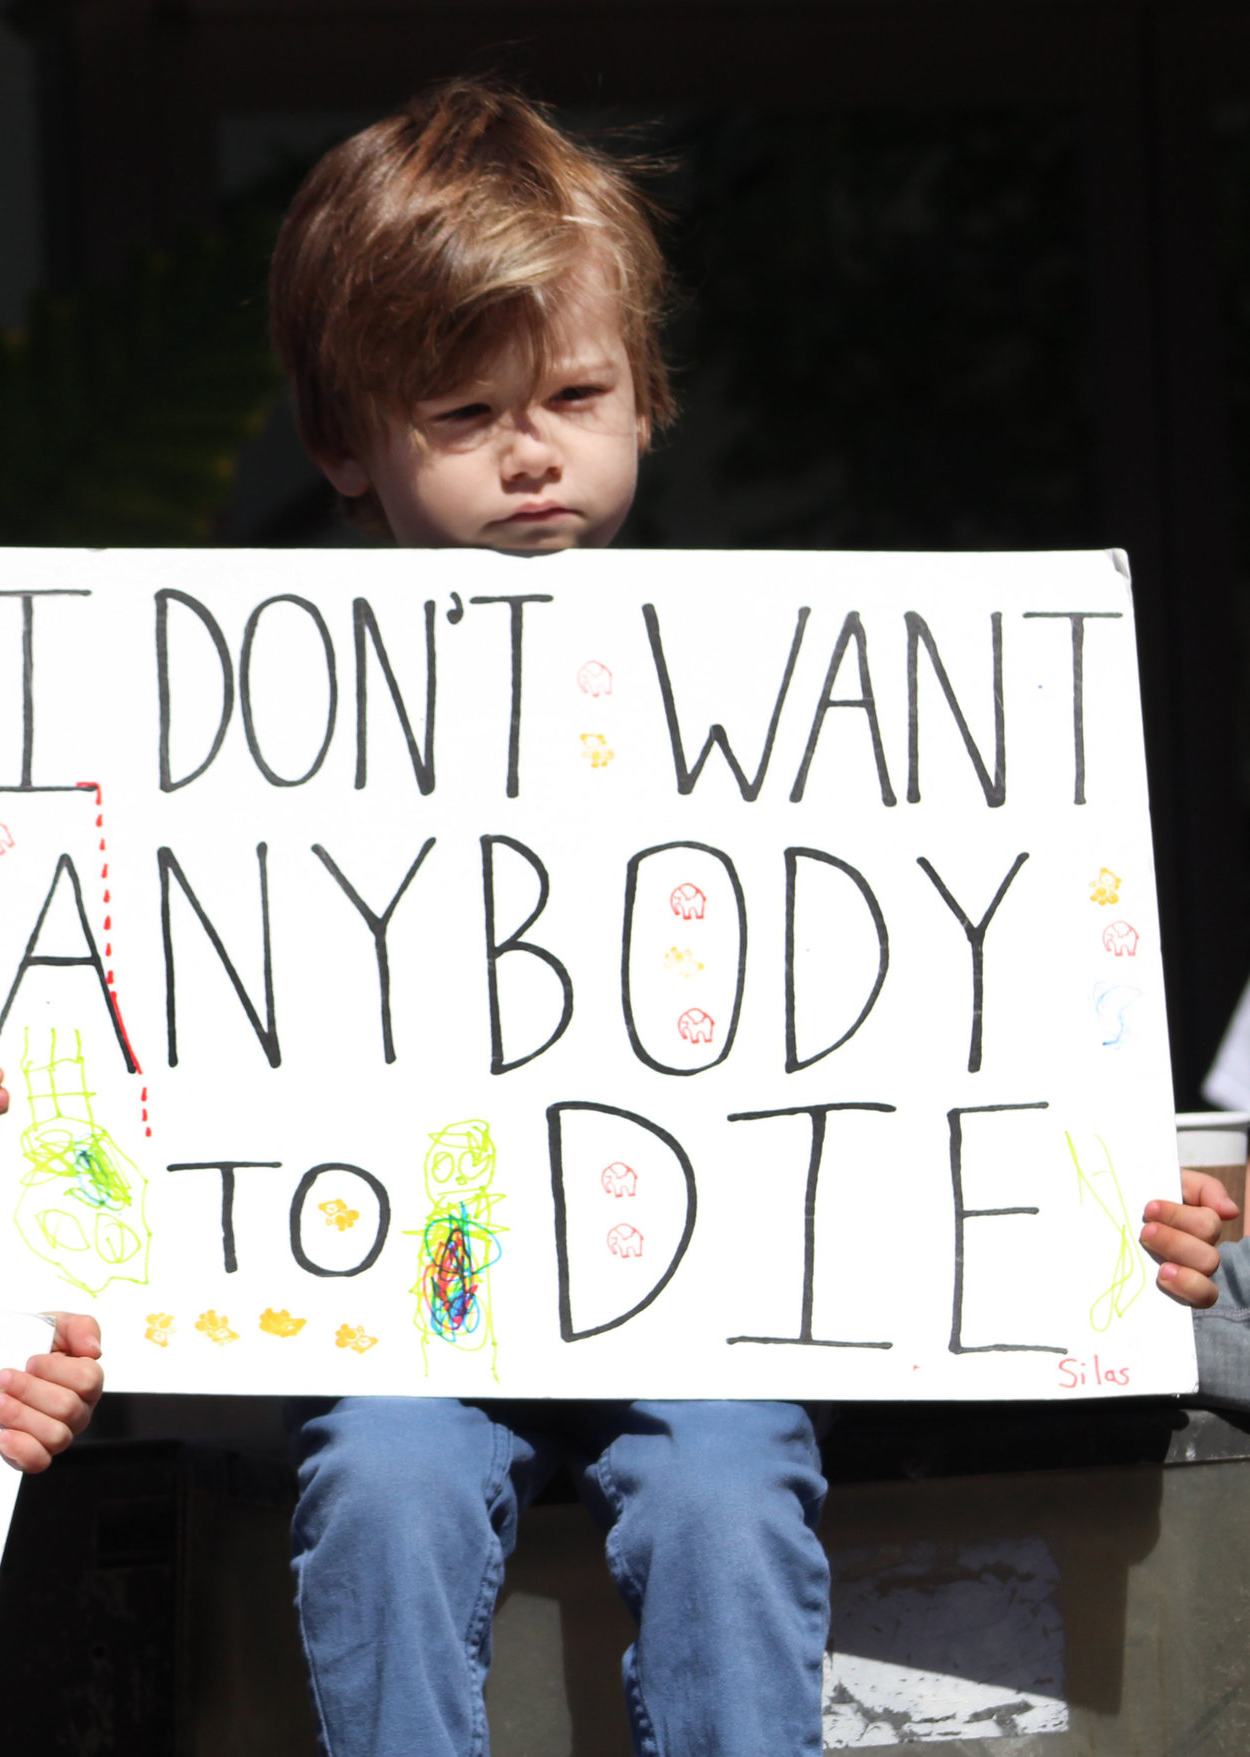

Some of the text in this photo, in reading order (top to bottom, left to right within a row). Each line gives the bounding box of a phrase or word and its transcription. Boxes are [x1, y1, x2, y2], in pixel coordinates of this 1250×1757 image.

[154, 587, 553, 798] DON'T
[642, 603, 1122, 808] WANT
[167, 1101, 1068, 1354] TO DIE
[1058, 1354, 1130, 1388] Silas
